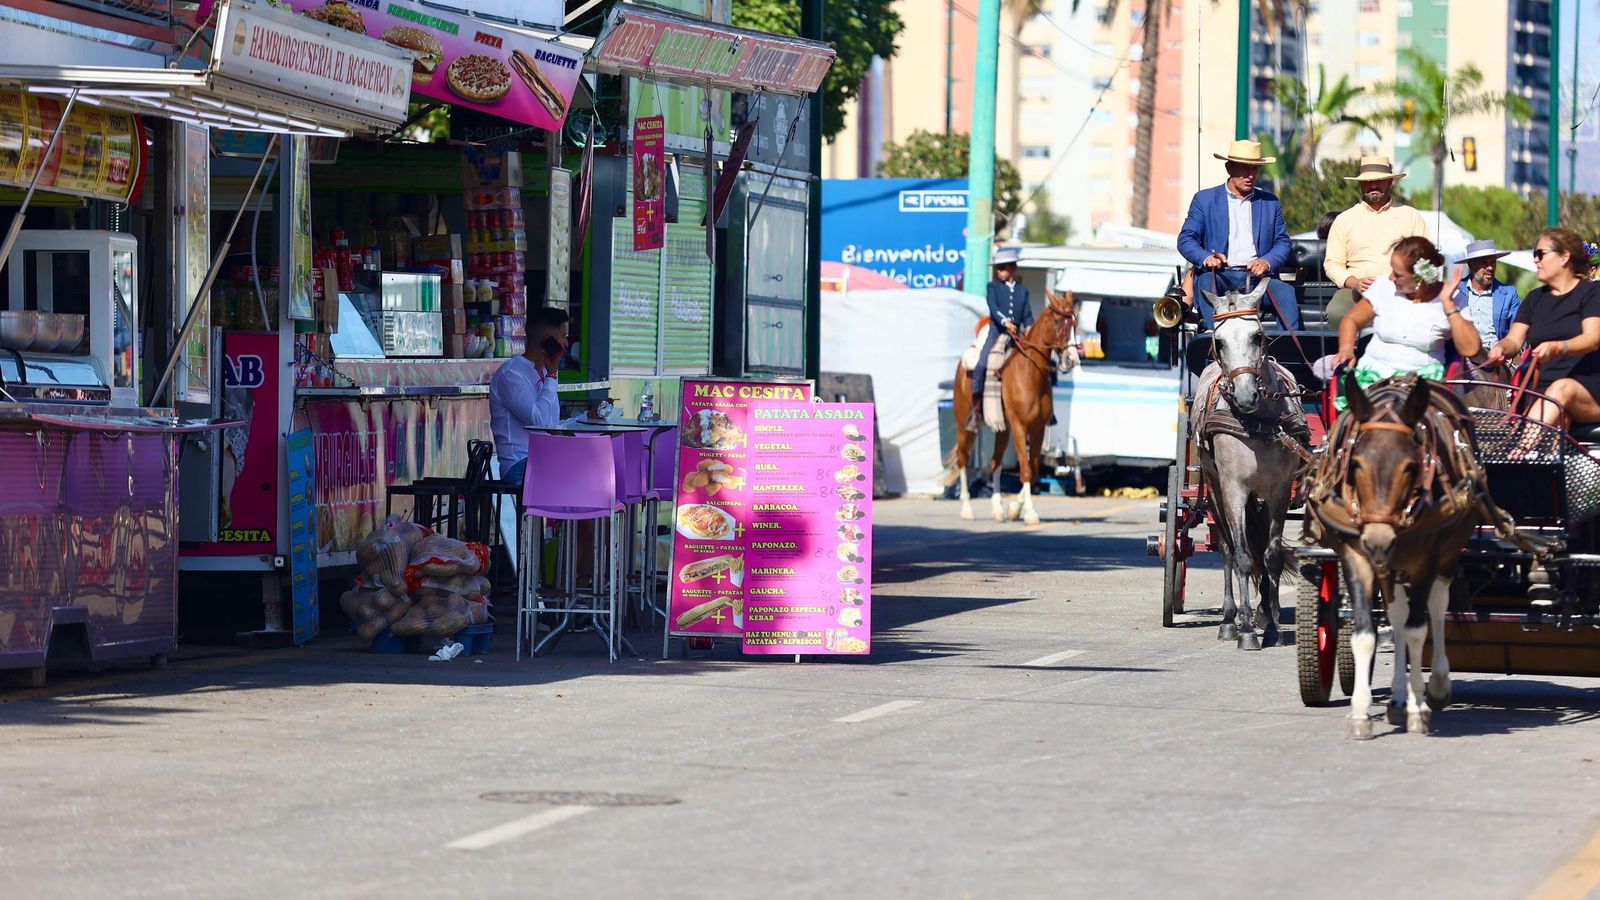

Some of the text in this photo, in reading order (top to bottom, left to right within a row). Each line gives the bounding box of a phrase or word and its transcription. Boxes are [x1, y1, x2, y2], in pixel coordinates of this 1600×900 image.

[474, 31, 503, 49] PIZZA
[248, 25, 393, 96] HAMBURGUESERIA EL BOGUERON
[534, 49, 578, 69] BAGUETTE
[694, 384, 805, 401] MAC CESITA
[754, 409, 865, 419] PATATA ASADA
